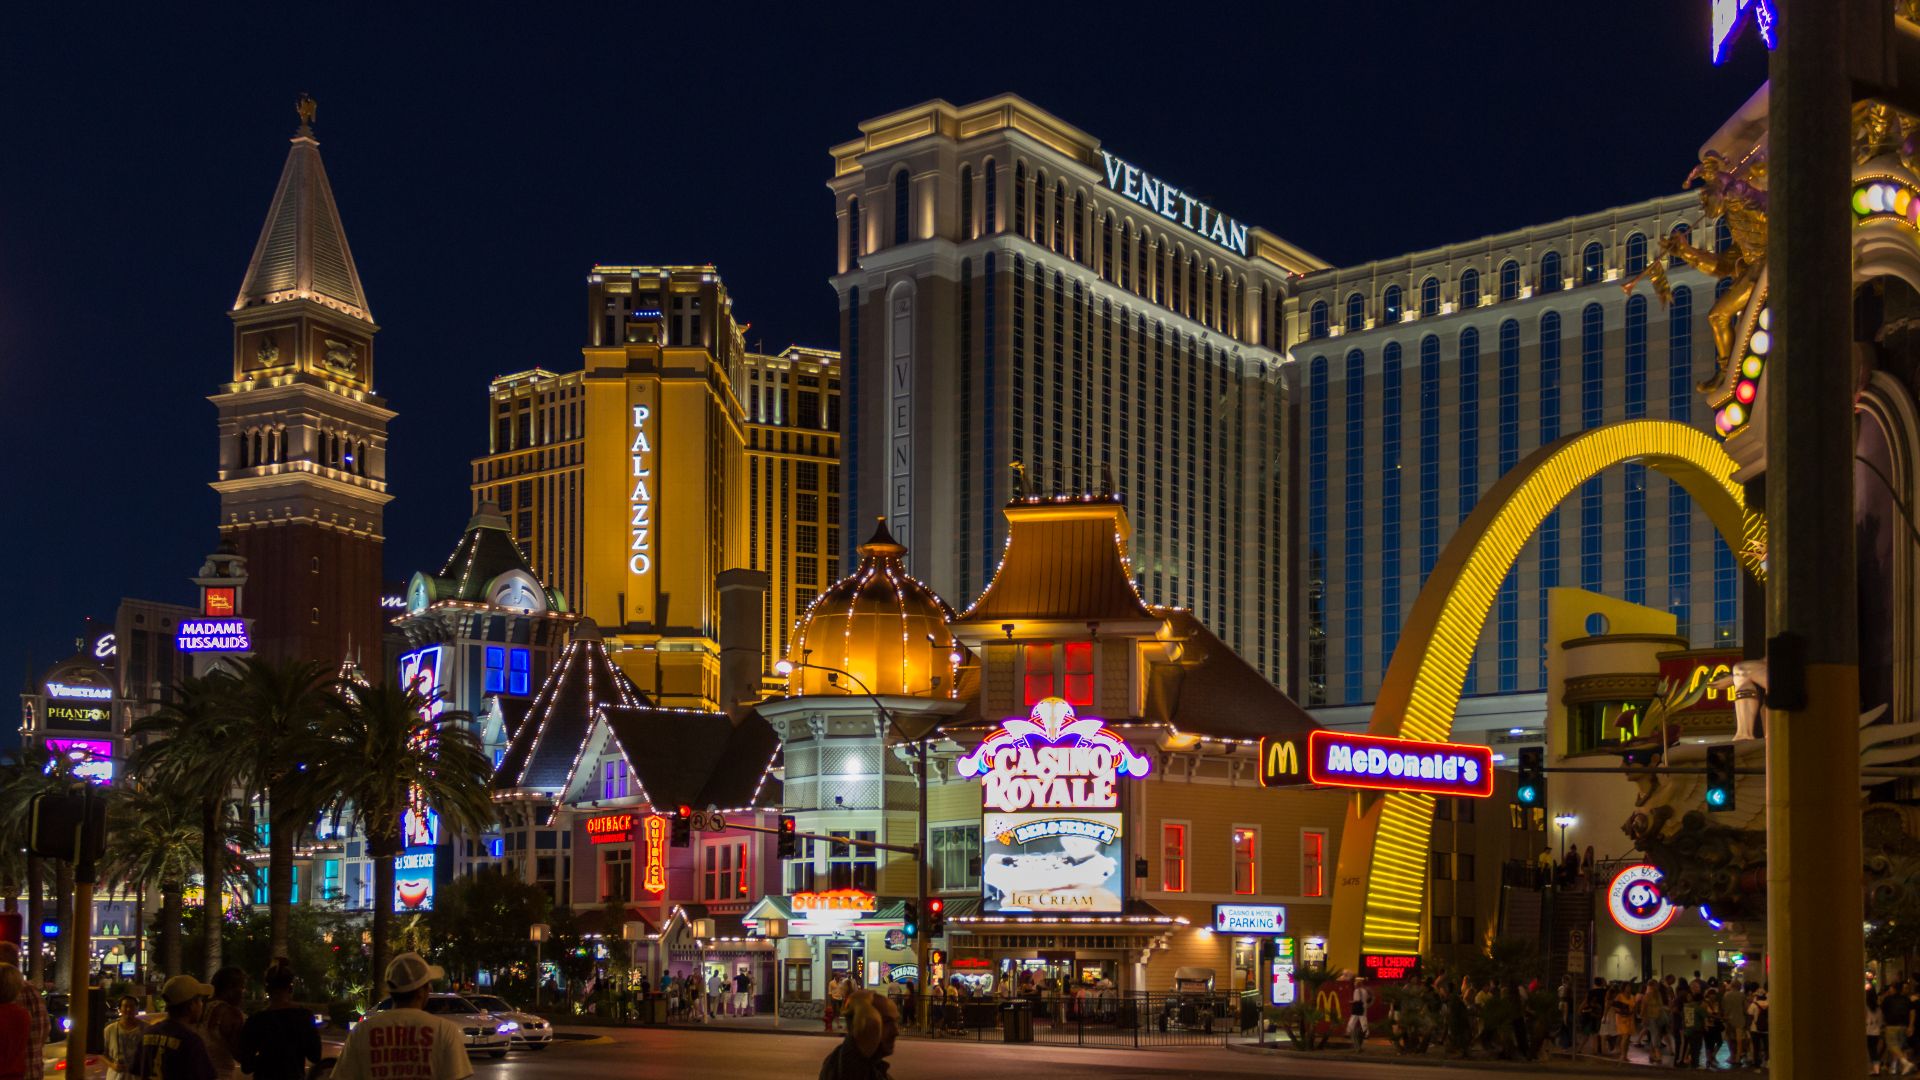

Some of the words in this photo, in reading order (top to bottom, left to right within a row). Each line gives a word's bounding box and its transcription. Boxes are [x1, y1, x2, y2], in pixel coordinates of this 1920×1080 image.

[1101, 149, 1249, 257] VENETIAN
[629, 404, 650, 574] PALAZZO
[182, 622, 244, 635] MADAME
[178, 635, 249, 649] TUSSAUD'S
[47, 706, 111, 721] PHANTOM
[994, 745, 1112, 777] CASINO
[1327, 745, 1479, 782] McDonald's
[982, 768, 1117, 812] ROYALE
[587, 815, 632, 834] OUTBACK
[650, 819, 660, 885] OUTBACK
[1613, 871, 1637, 898] PANDA
[792, 895, 875, 911] OUTBACK
[1012, 892, 1031, 905] ICE
[1039, 892, 1094, 905] CREAM
[1229, 917, 1274, 928] PARKING
[1384, 956, 1416, 968] CHERRY
[1377, 967, 1405, 979] BERRY
[369, 1025, 434, 1048] GIRLS
[370, 1047, 433, 1064] DIRECT
[370, 1065, 388, 1078] TO
